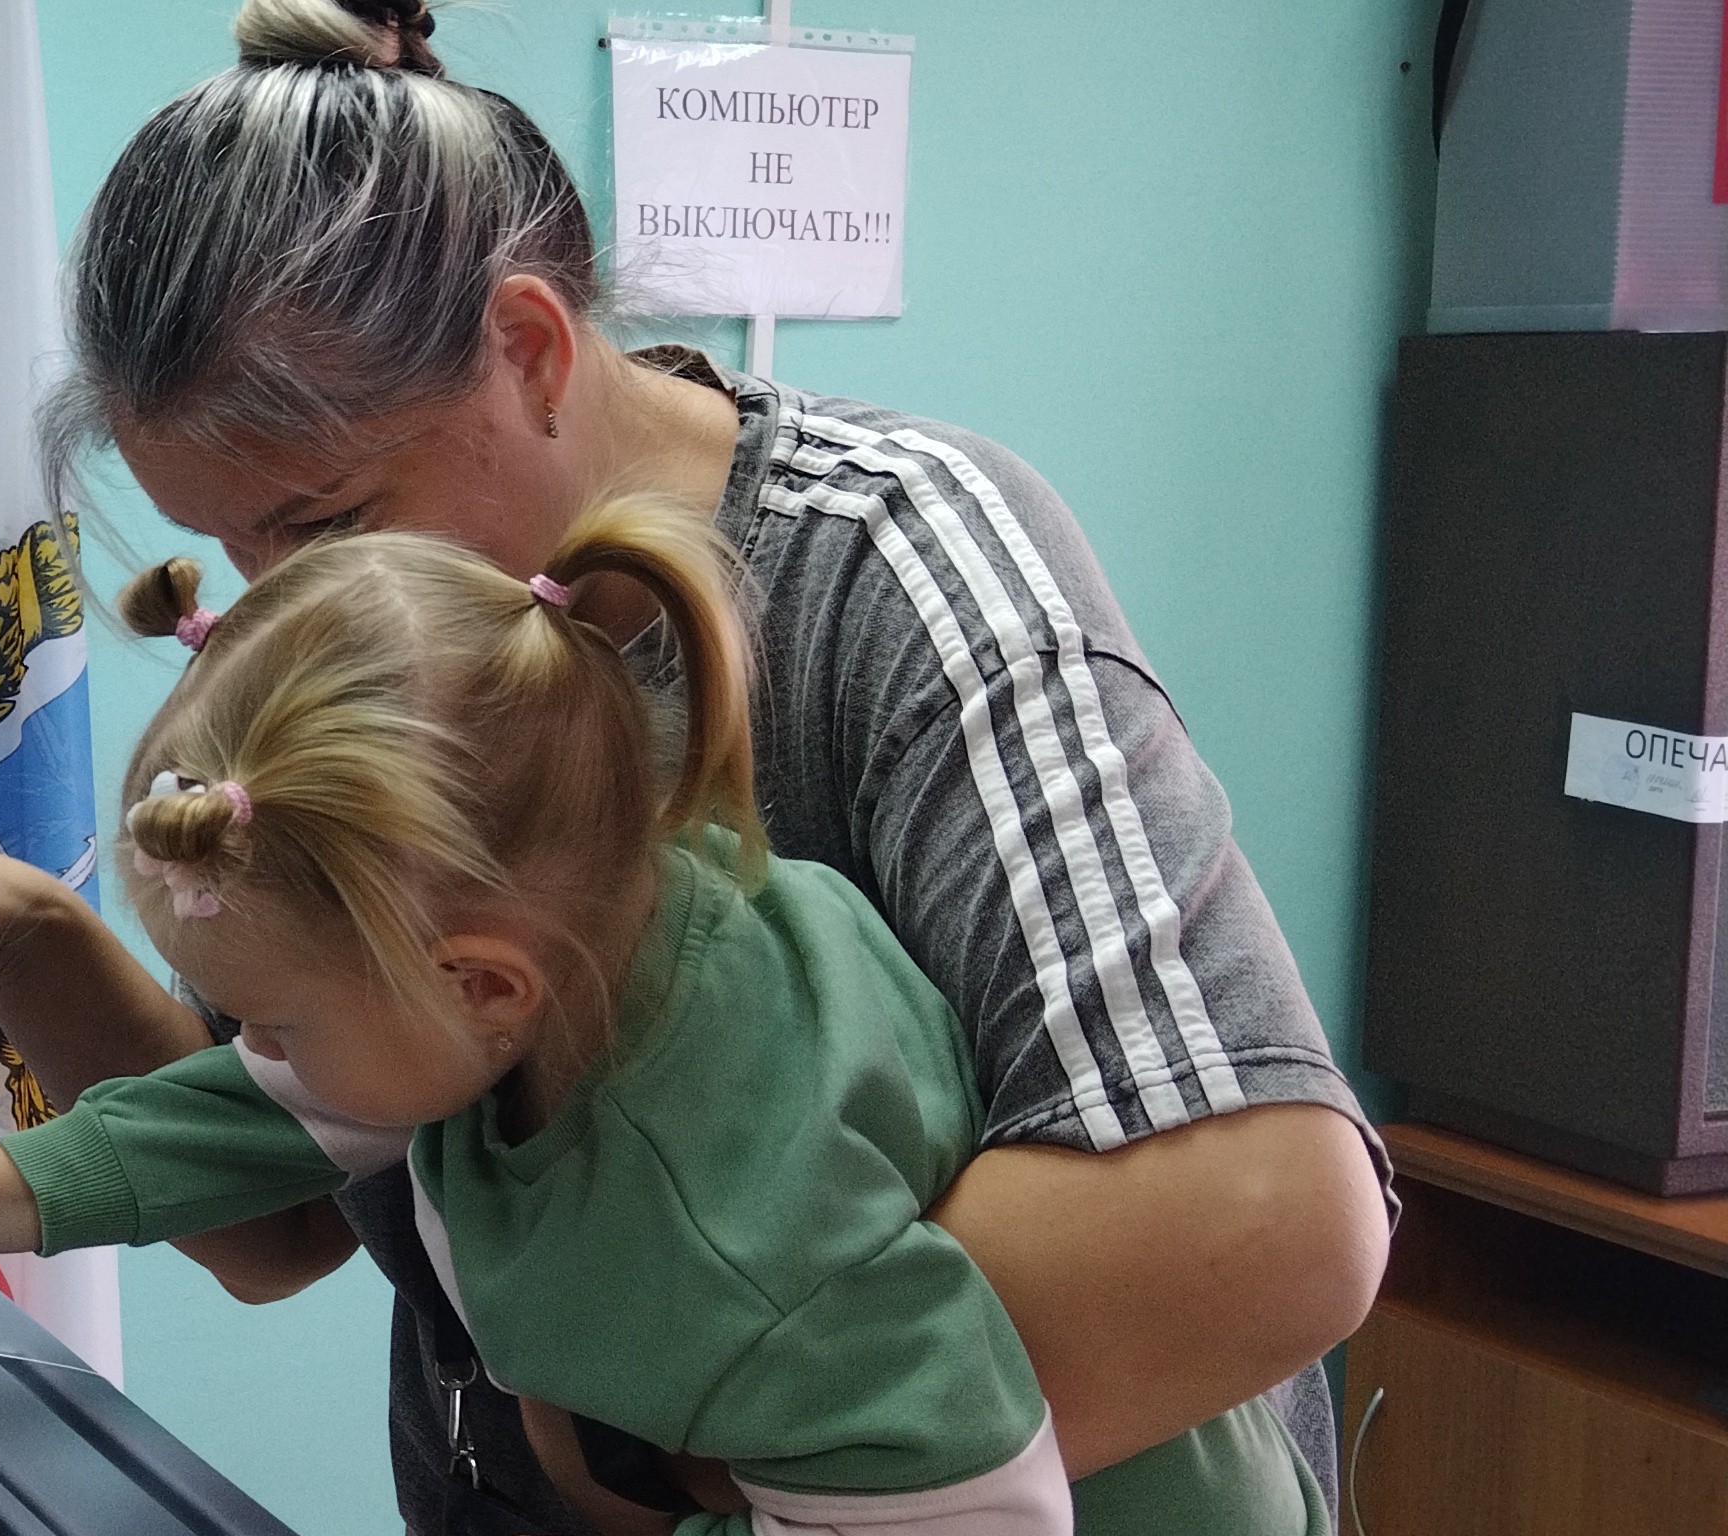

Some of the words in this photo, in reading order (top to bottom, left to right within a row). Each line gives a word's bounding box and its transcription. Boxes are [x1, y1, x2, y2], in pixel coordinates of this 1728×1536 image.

[657, 87, 879, 130] КОМПЬЮТЕР
[750, 152, 793, 185] НЕ
[639, 204, 890, 243] ВЫКЛЮЧАТЬ!!!
